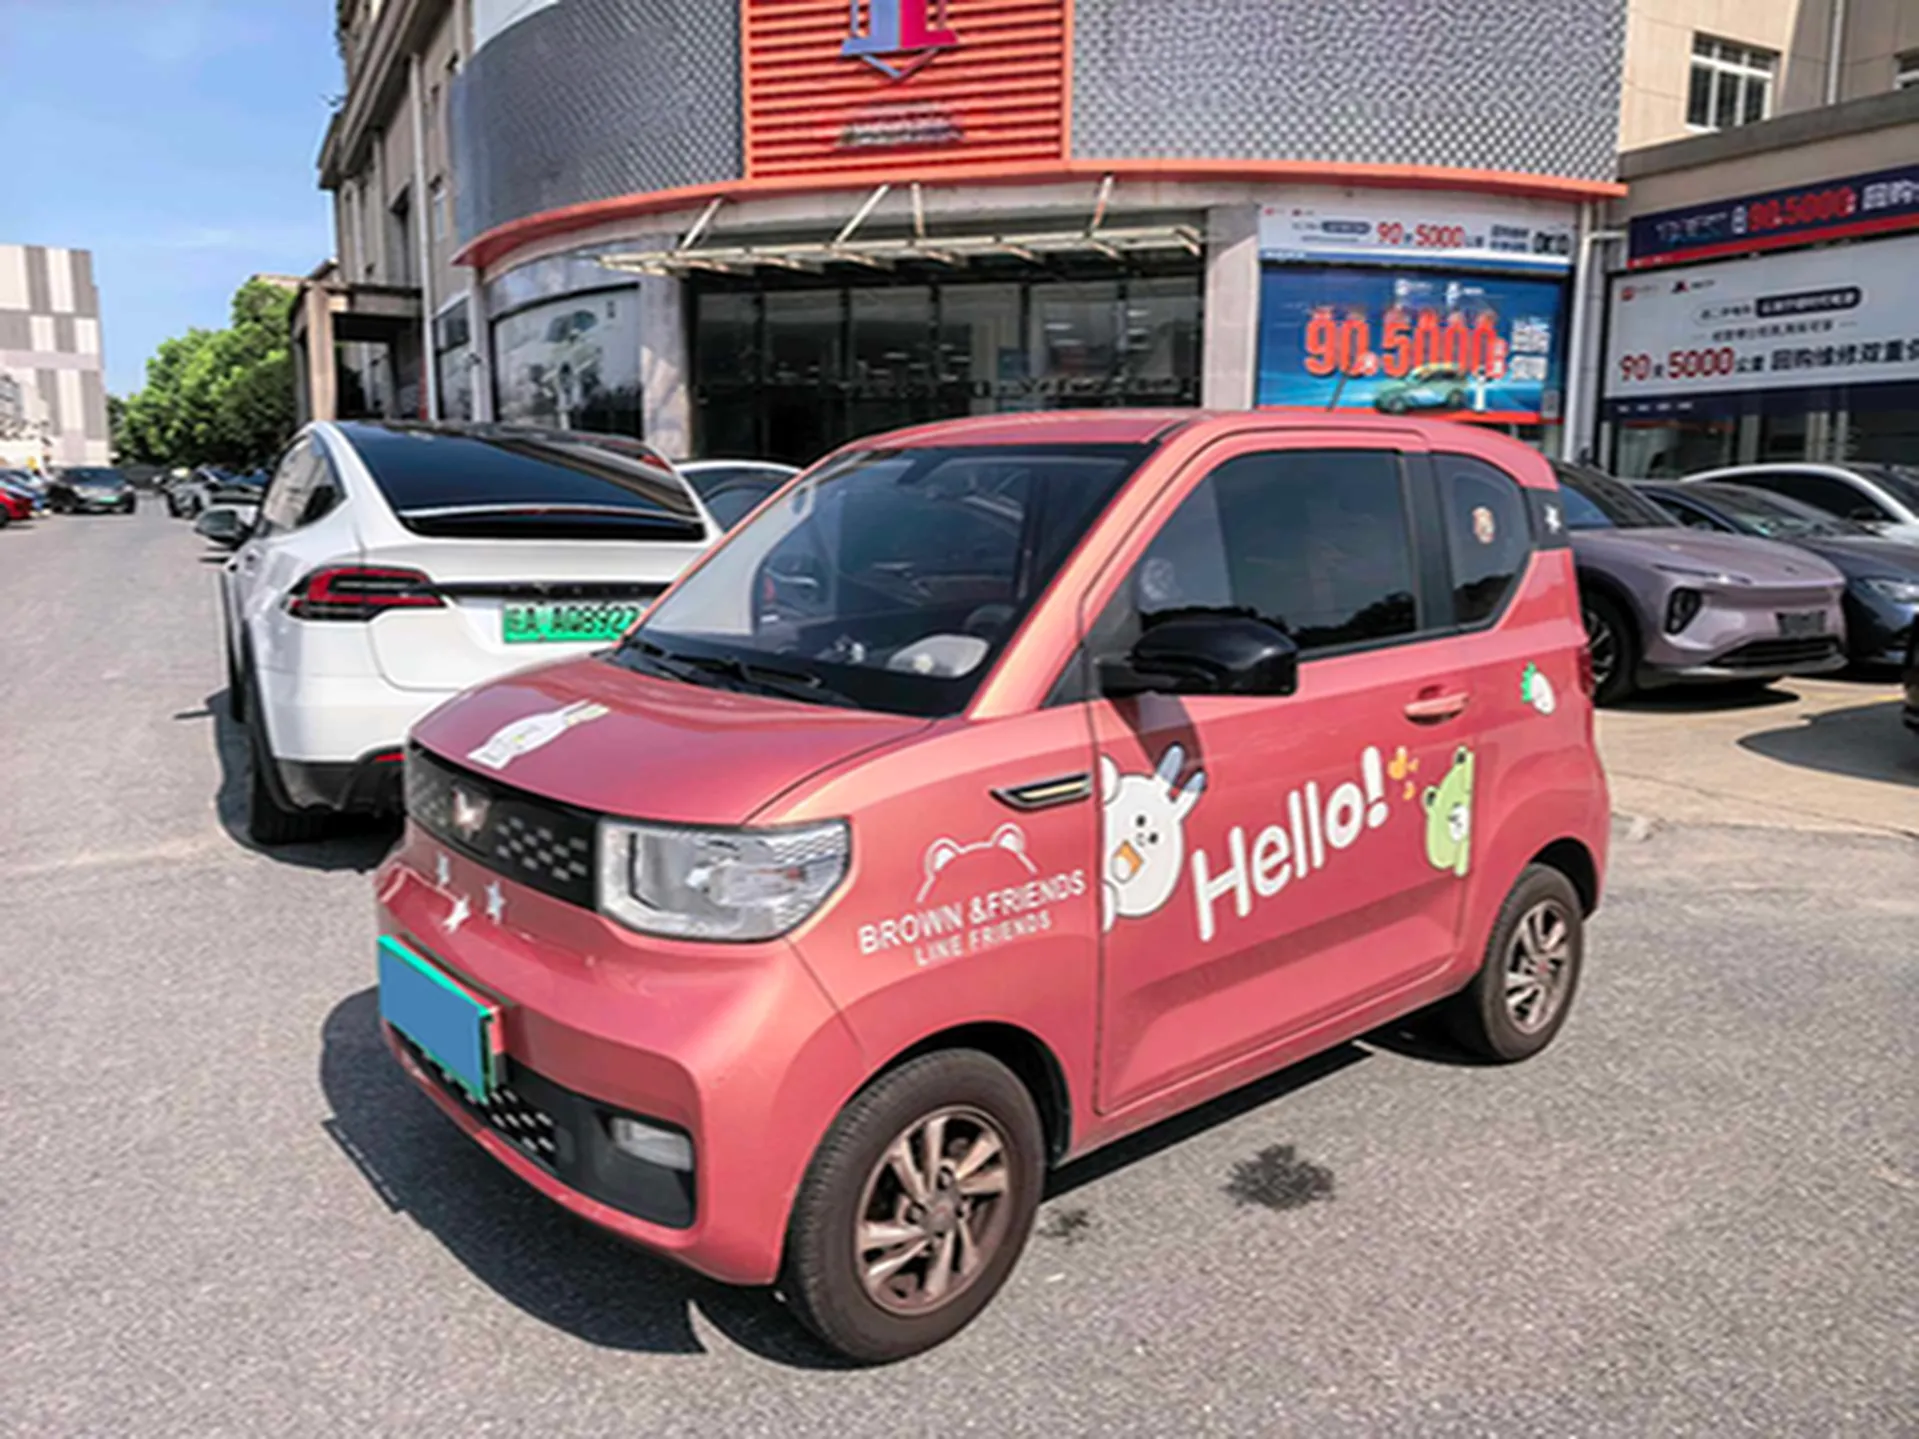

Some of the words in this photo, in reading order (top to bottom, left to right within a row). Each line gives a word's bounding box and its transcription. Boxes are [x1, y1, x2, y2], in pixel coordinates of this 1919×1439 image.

[1190, 745, 1389, 943] Hello!
[857, 902, 965, 956] BROWN
[914, 934, 964, 967] LINE
[968, 910, 1052, 948] FRIENDS
